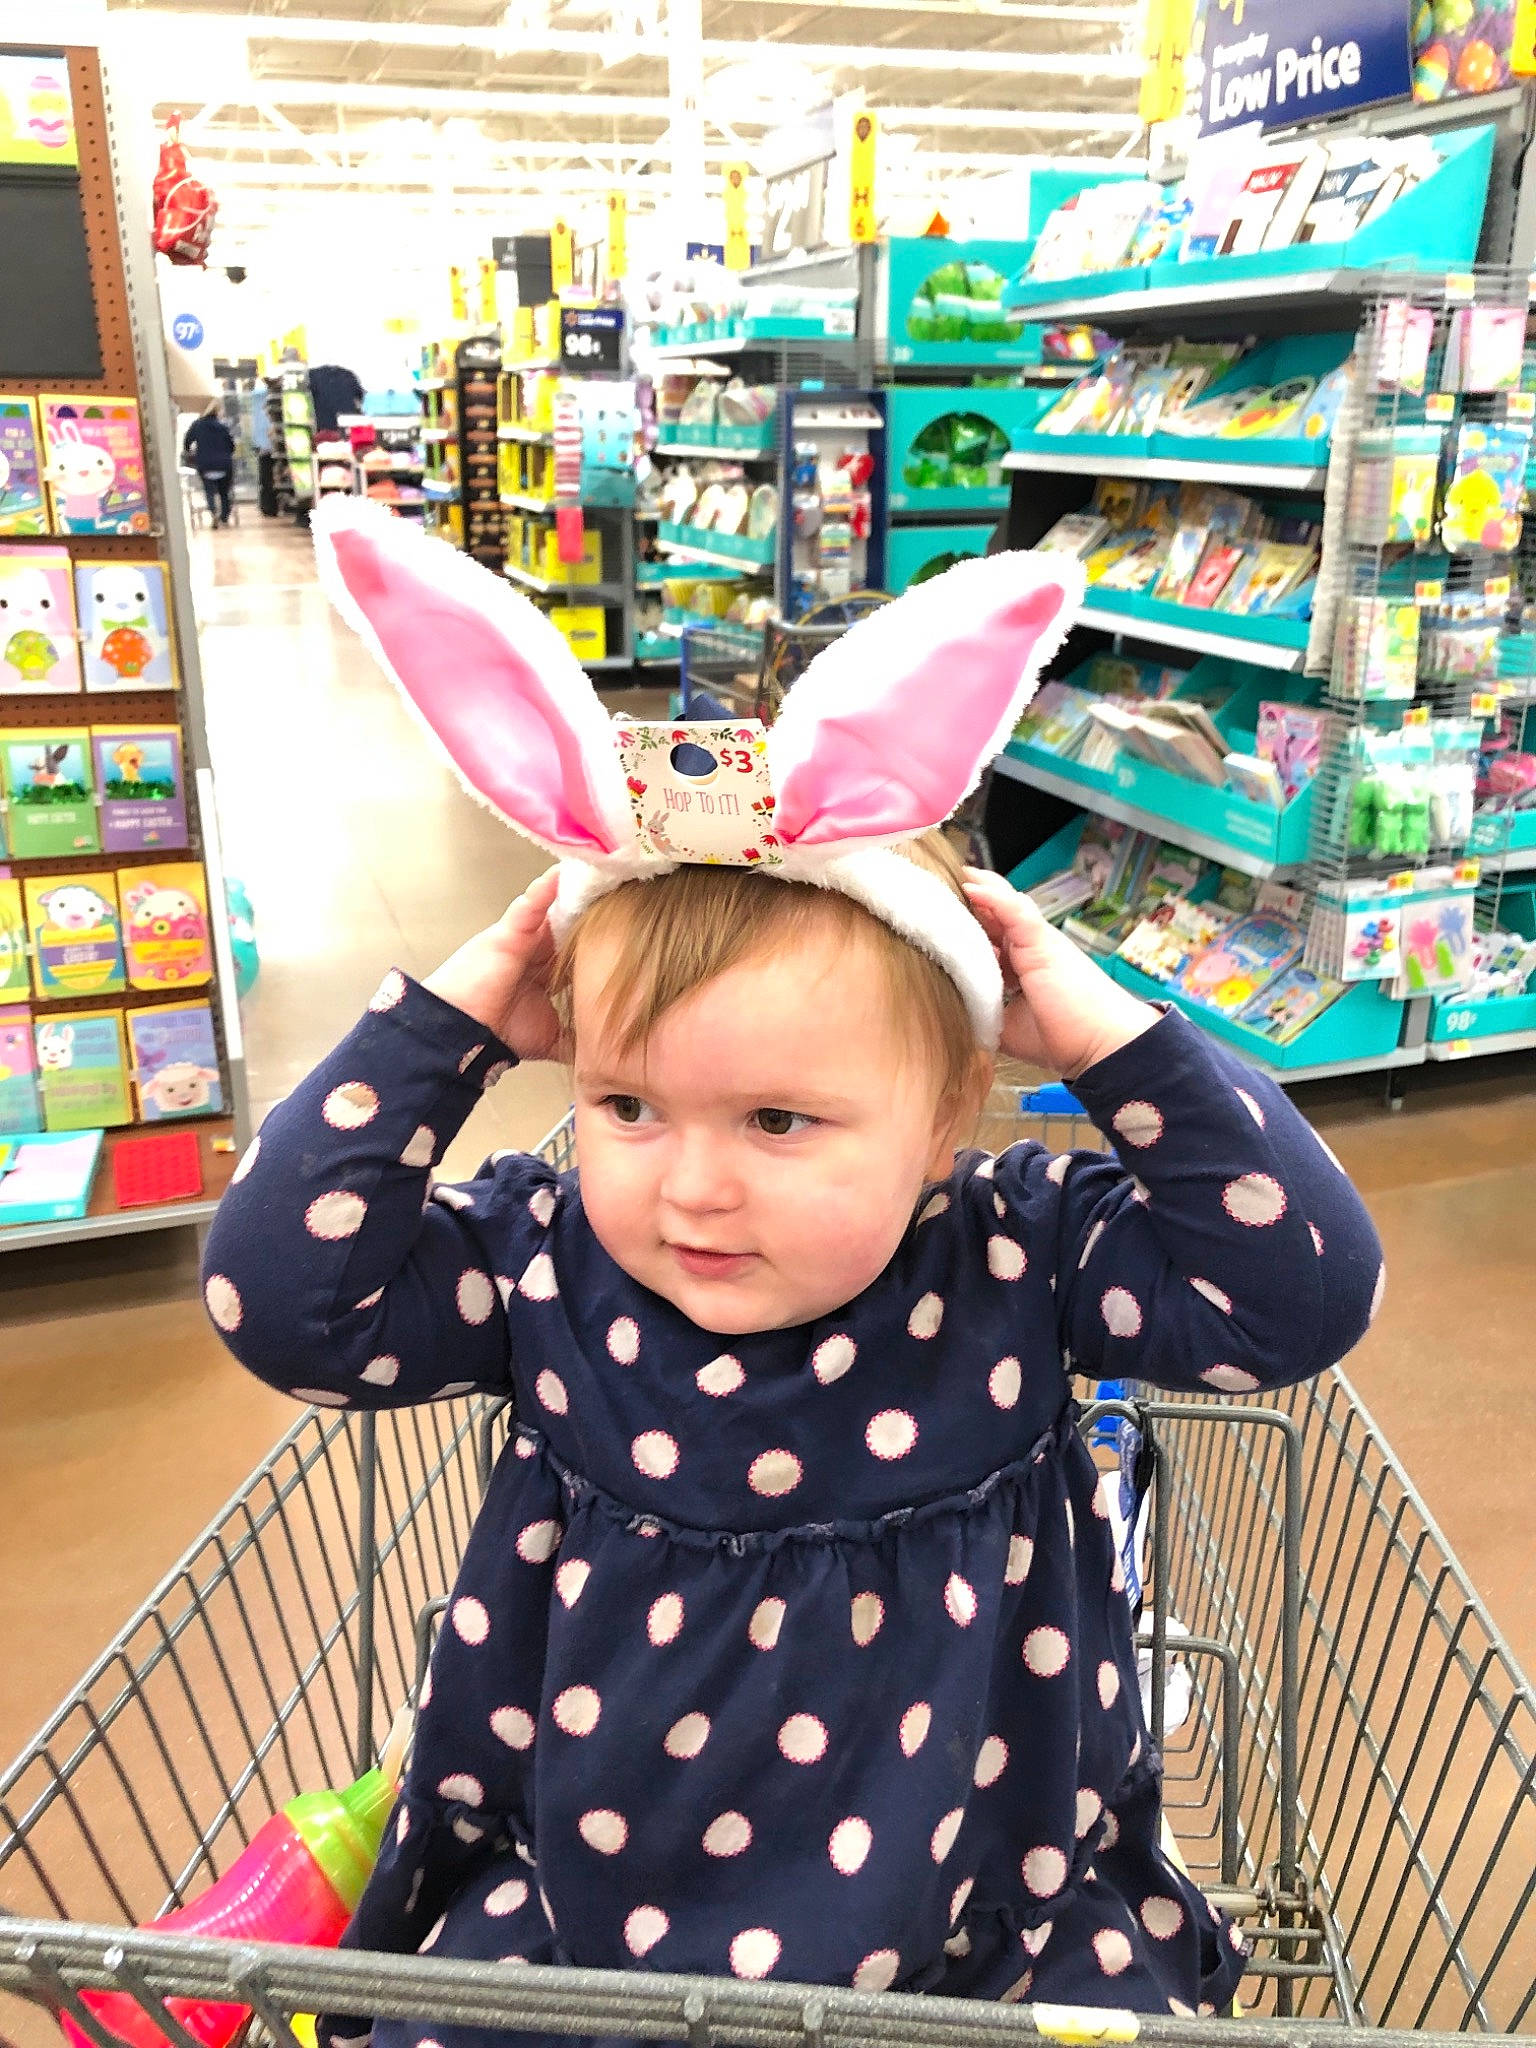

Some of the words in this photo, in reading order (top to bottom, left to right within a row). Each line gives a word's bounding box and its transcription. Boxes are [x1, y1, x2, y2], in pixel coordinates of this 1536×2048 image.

[1208, 66, 1272, 123] Low
[1275, 35, 1361, 104] Price
[719, 747, 754, 774] $3
[663, 788, 692, 813] HOP
[718, 793, 740, 816] IT!
